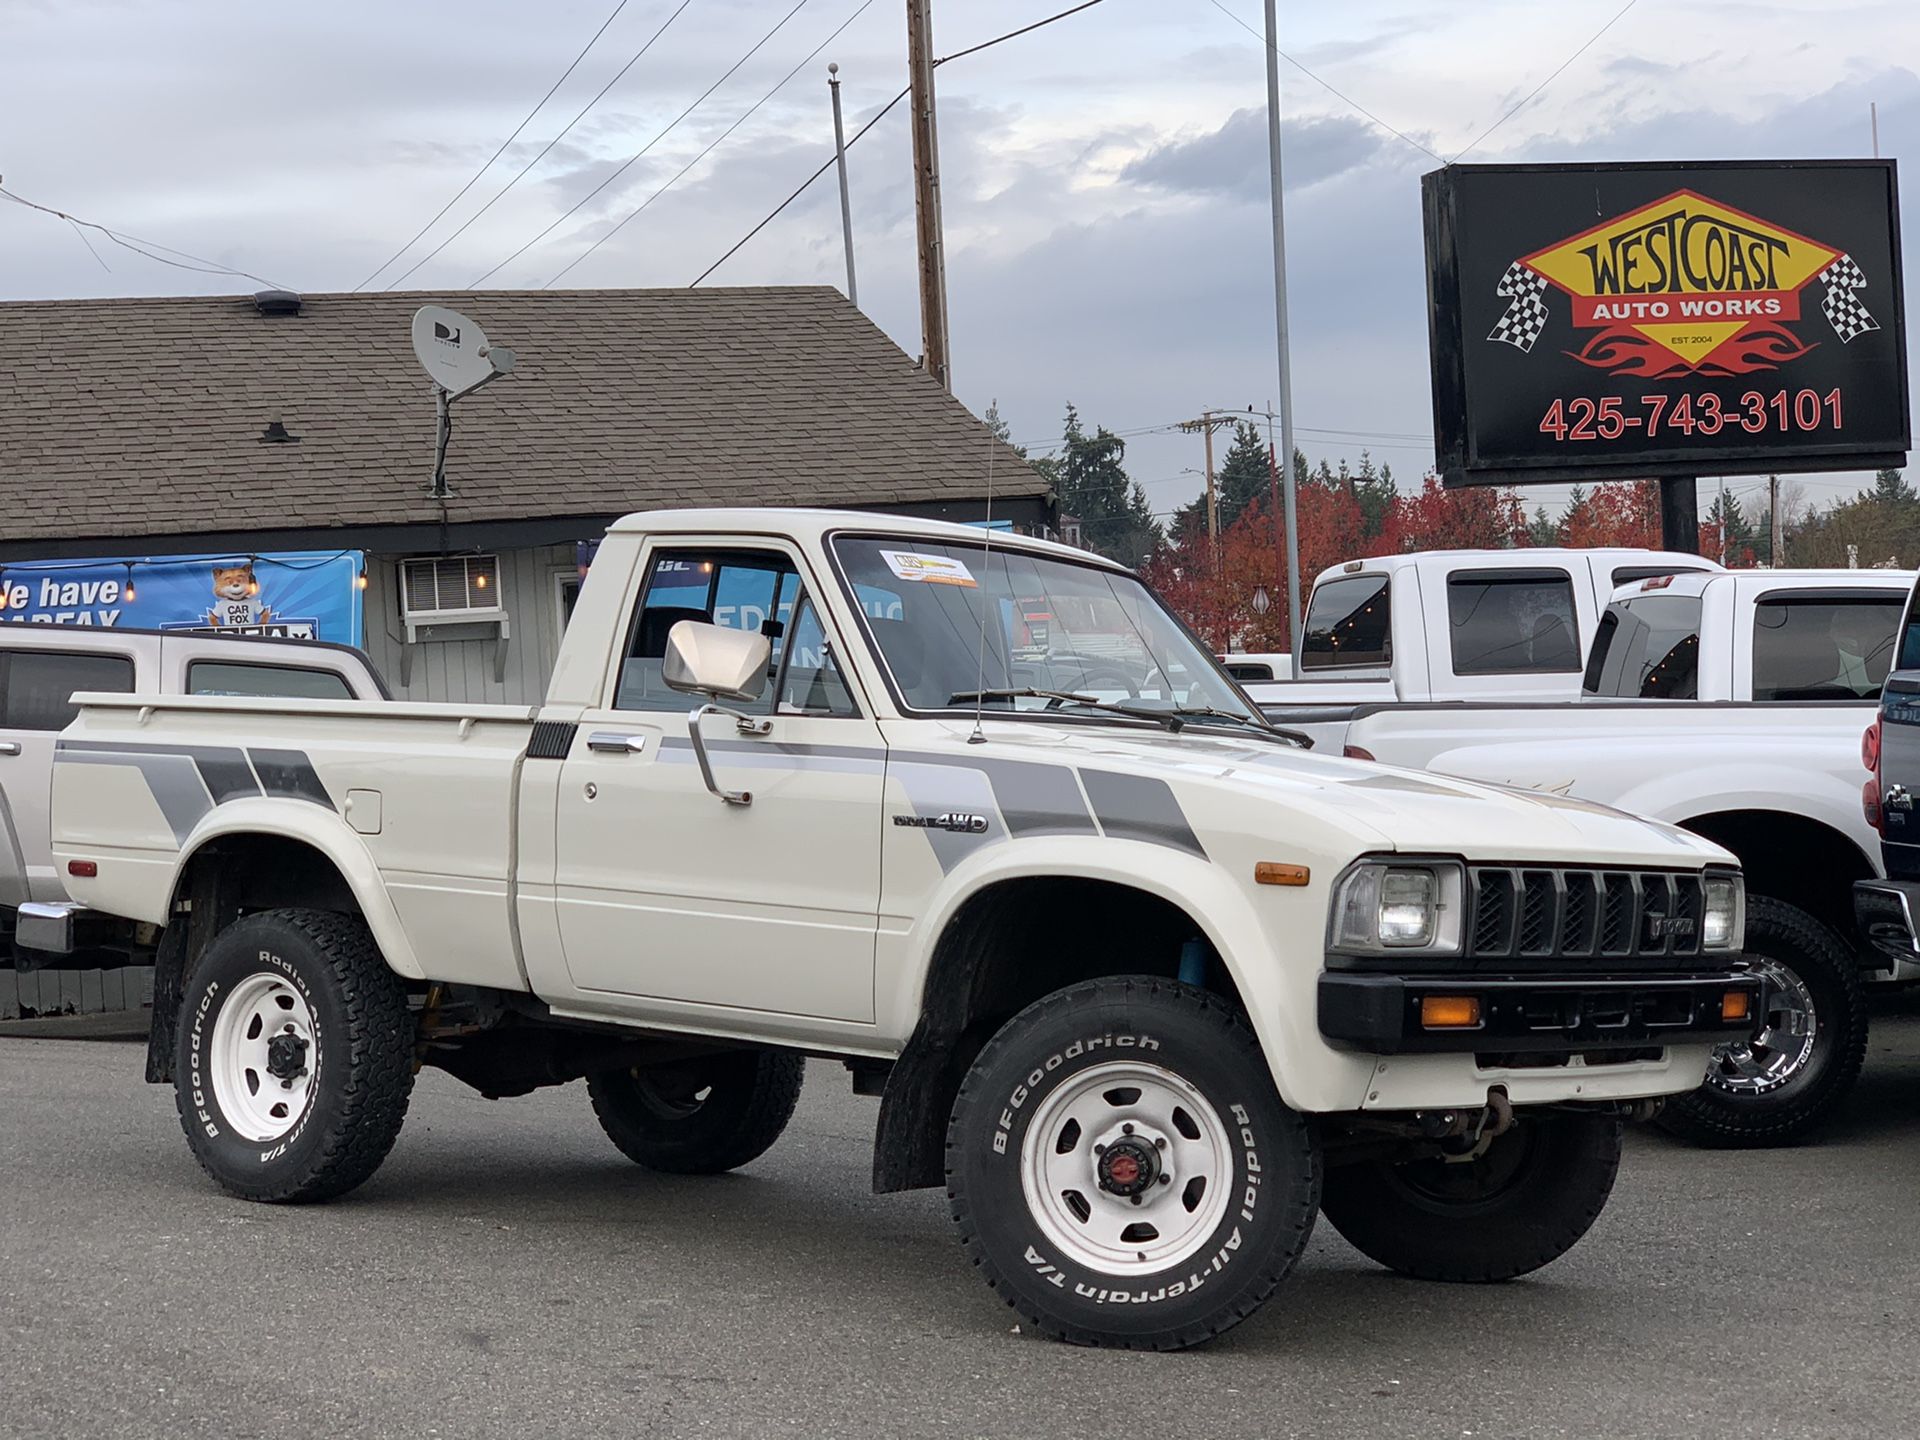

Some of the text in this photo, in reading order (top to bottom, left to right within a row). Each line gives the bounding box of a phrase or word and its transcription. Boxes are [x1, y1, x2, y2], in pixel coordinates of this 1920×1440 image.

[1592, 299, 1781, 320] AUTO WORKS
[1671, 336, 1712, 345] EST 2004
[1539, 388, 1843, 440] 425-743-3101
[39, 577, 119, 607] have
[227, 604, 249, 615] CAR
[229, 614, 249, 624] FOX
[935, 813, 988, 832] 4WD
[191, 981, 219, 1138] BFGoodrich
[992, 1033, 1161, 1155] BFGoodrich
[1023, 1103, 1262, 1305] Radial All-Terrain T/A
